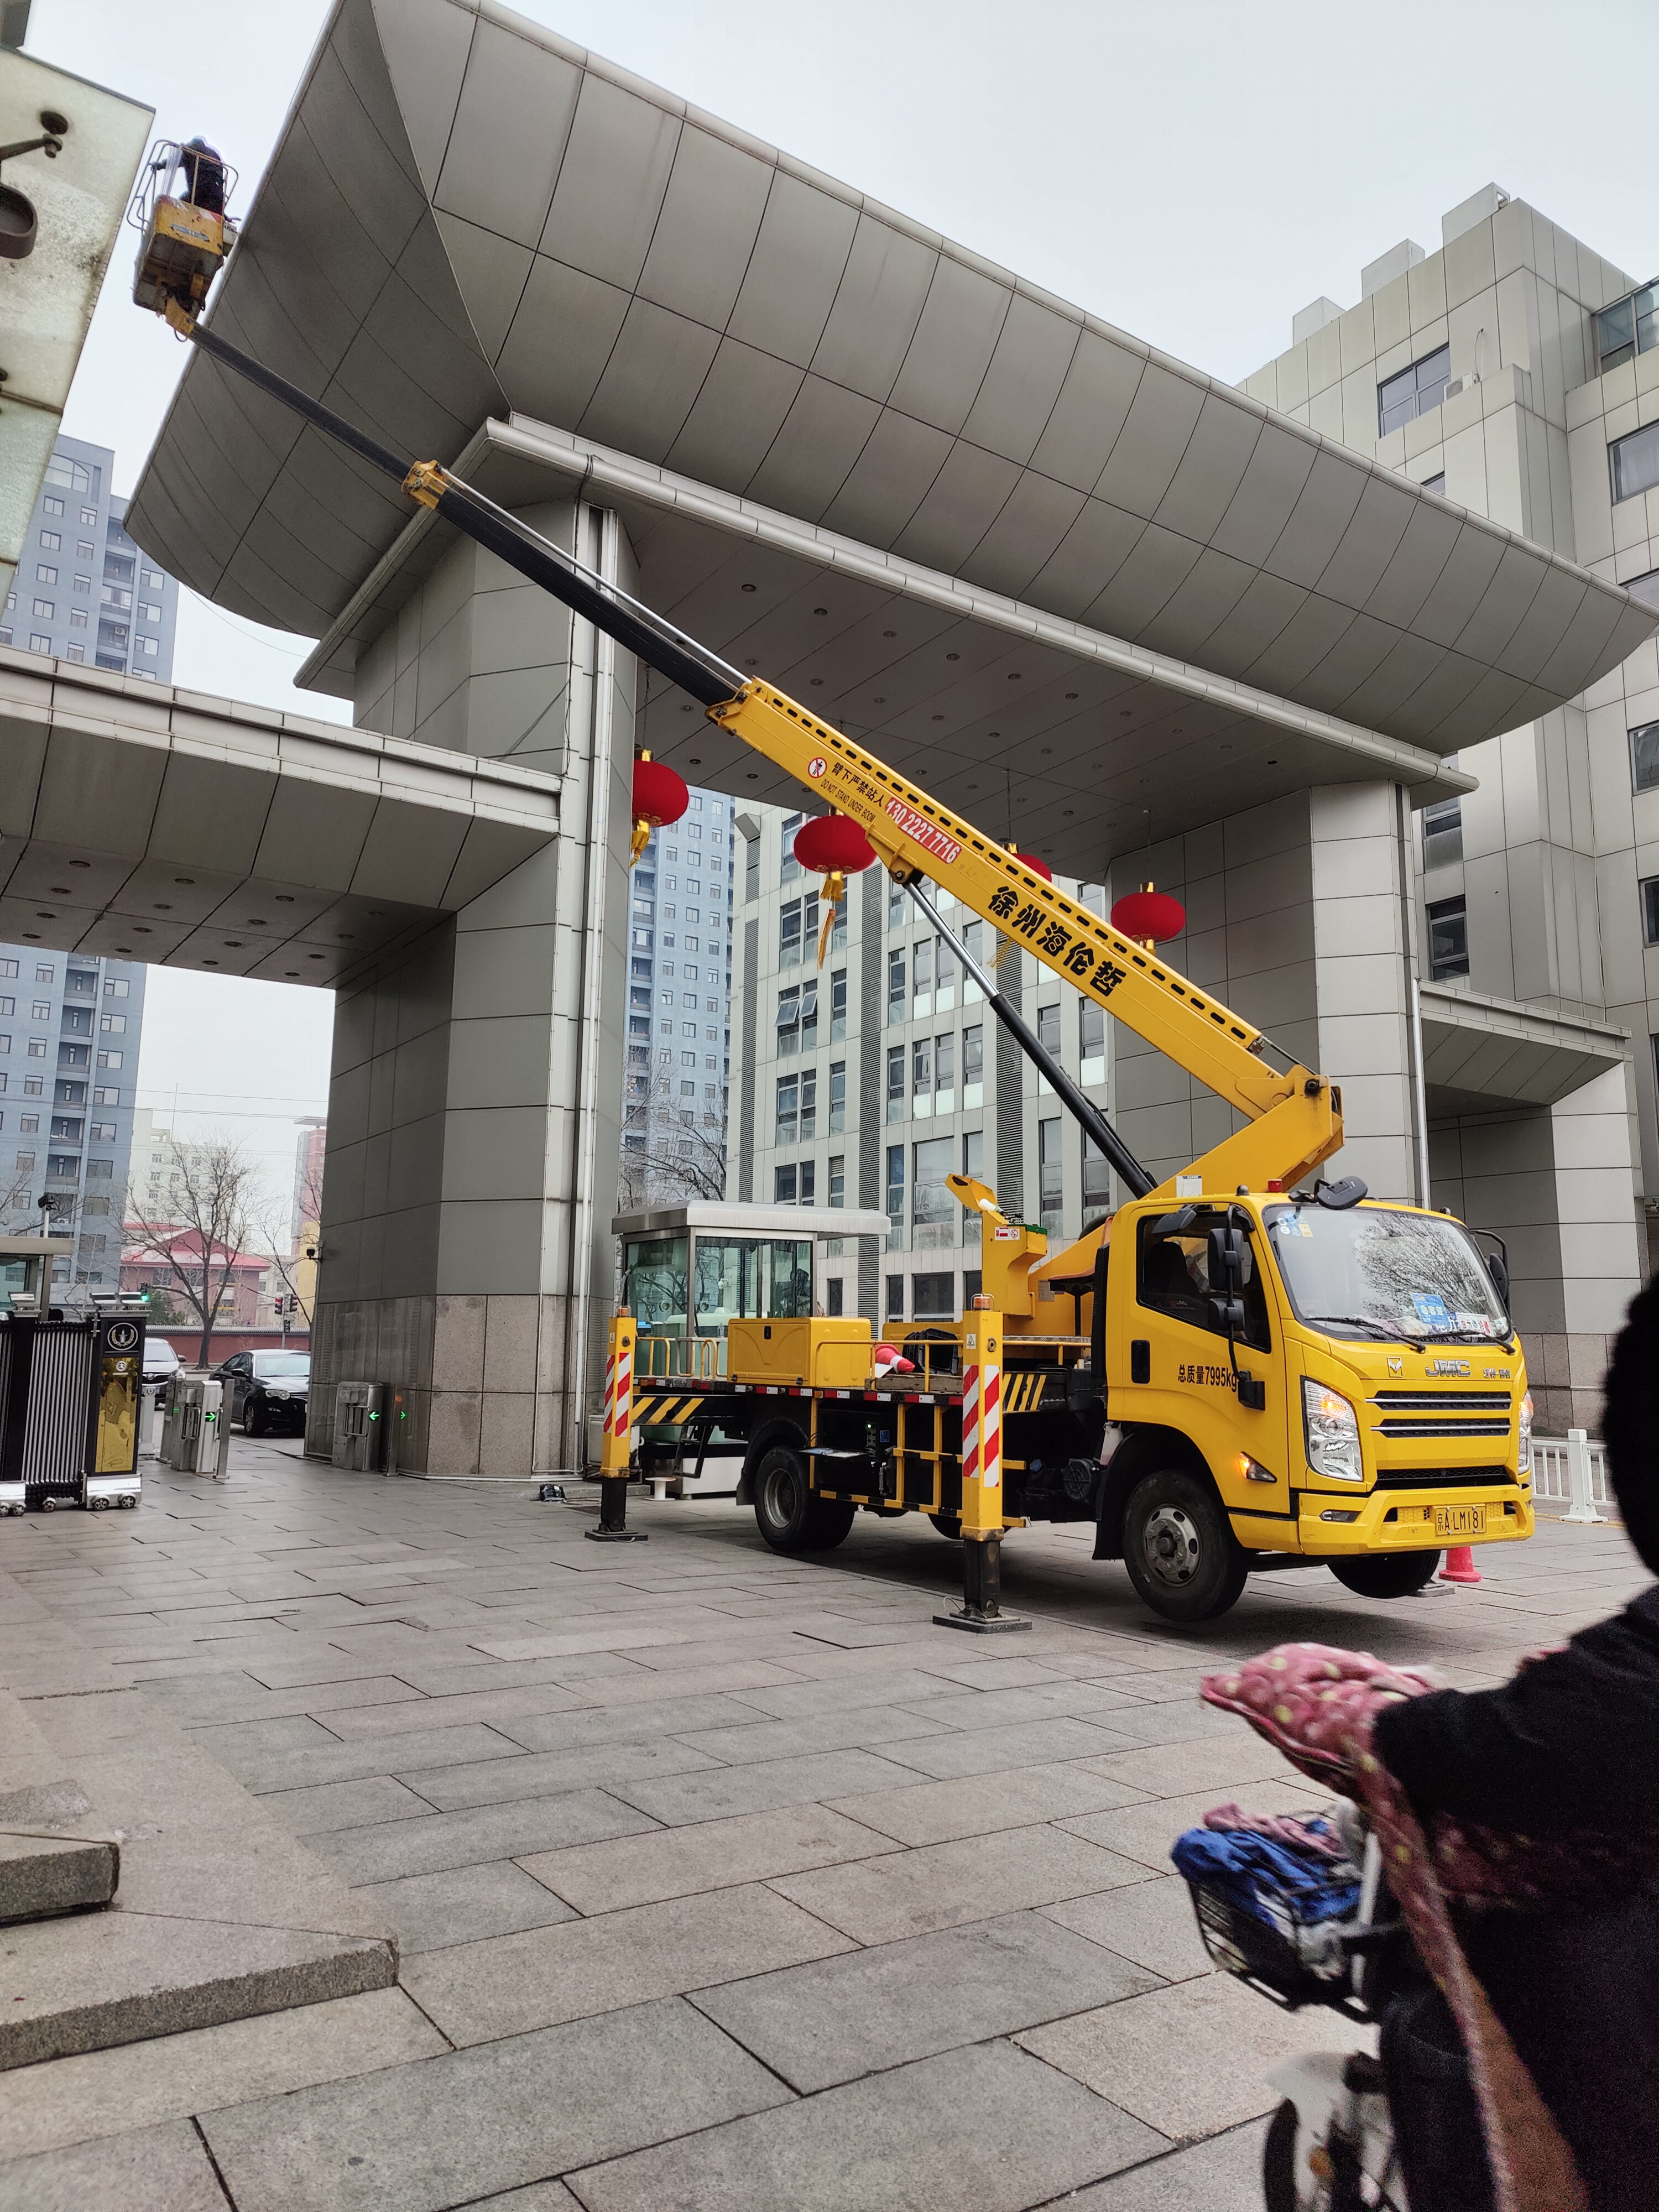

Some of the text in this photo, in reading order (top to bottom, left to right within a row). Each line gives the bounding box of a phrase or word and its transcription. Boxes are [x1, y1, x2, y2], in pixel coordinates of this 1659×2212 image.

[821, 779, 876, 822] DO NOT STAND UNDER BOOM
[831, 762, 884, 807] 臂下严禁站人
[885, 800, 960, 863] 130 2227 7716
[988, 886, 1126, 997] 徐州海伦哲
[1178, 1364, 1237, 1392] 总质量7995kg
[1425, 1359, 1470, 1377] JMC
